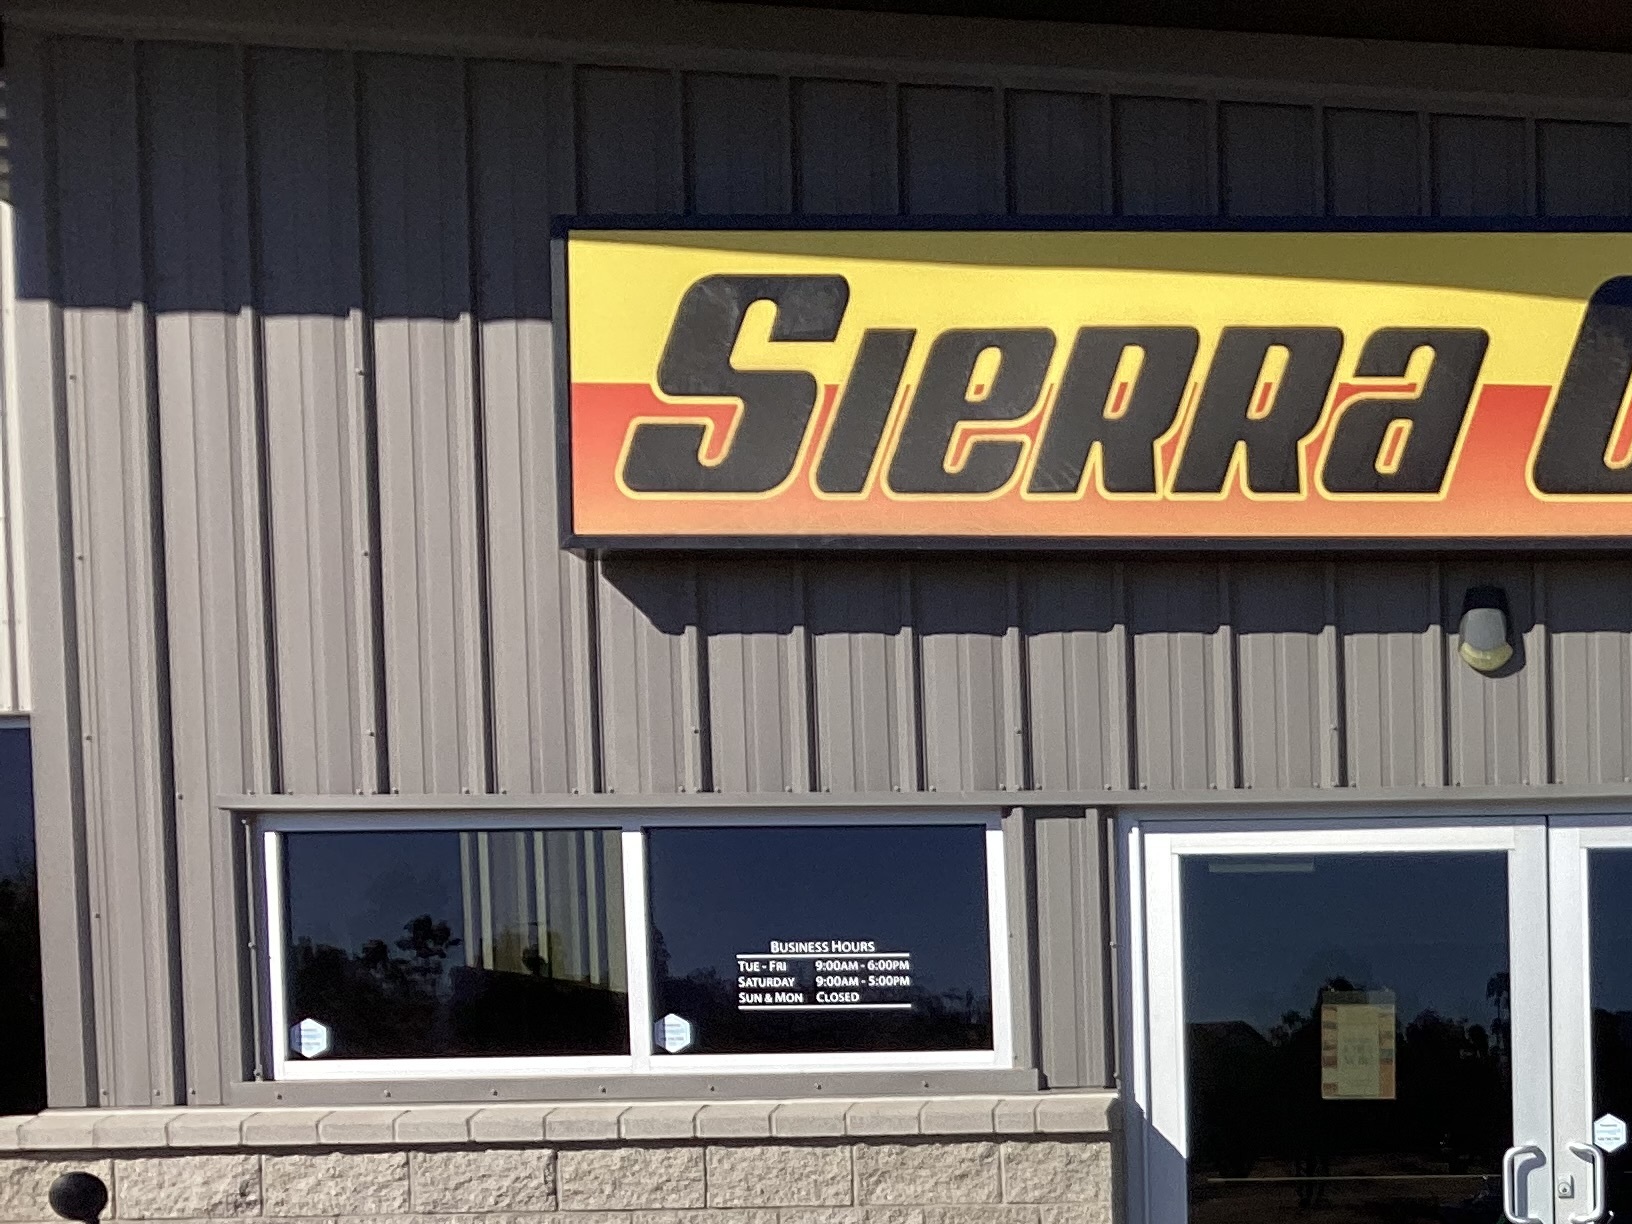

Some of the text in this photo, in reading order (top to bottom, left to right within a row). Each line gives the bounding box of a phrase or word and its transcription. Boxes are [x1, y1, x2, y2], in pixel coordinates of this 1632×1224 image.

[770, 941, 875, 953] BUSINESS HOURS
[738, 960, 760, 972] TUE
[769, 960, 787, 972] FRI
[815, 960, 859, 971] 9:00AM
[867, 959, 910, 971] 6:00PM
[738, 977, 795, 988] SATURDAY
[815, 976, 859, 987] 9:00AM
[868, 976, 910, 987] 5:00PM
[738, 991, 860, 1003] SUN & MON CLOSED
